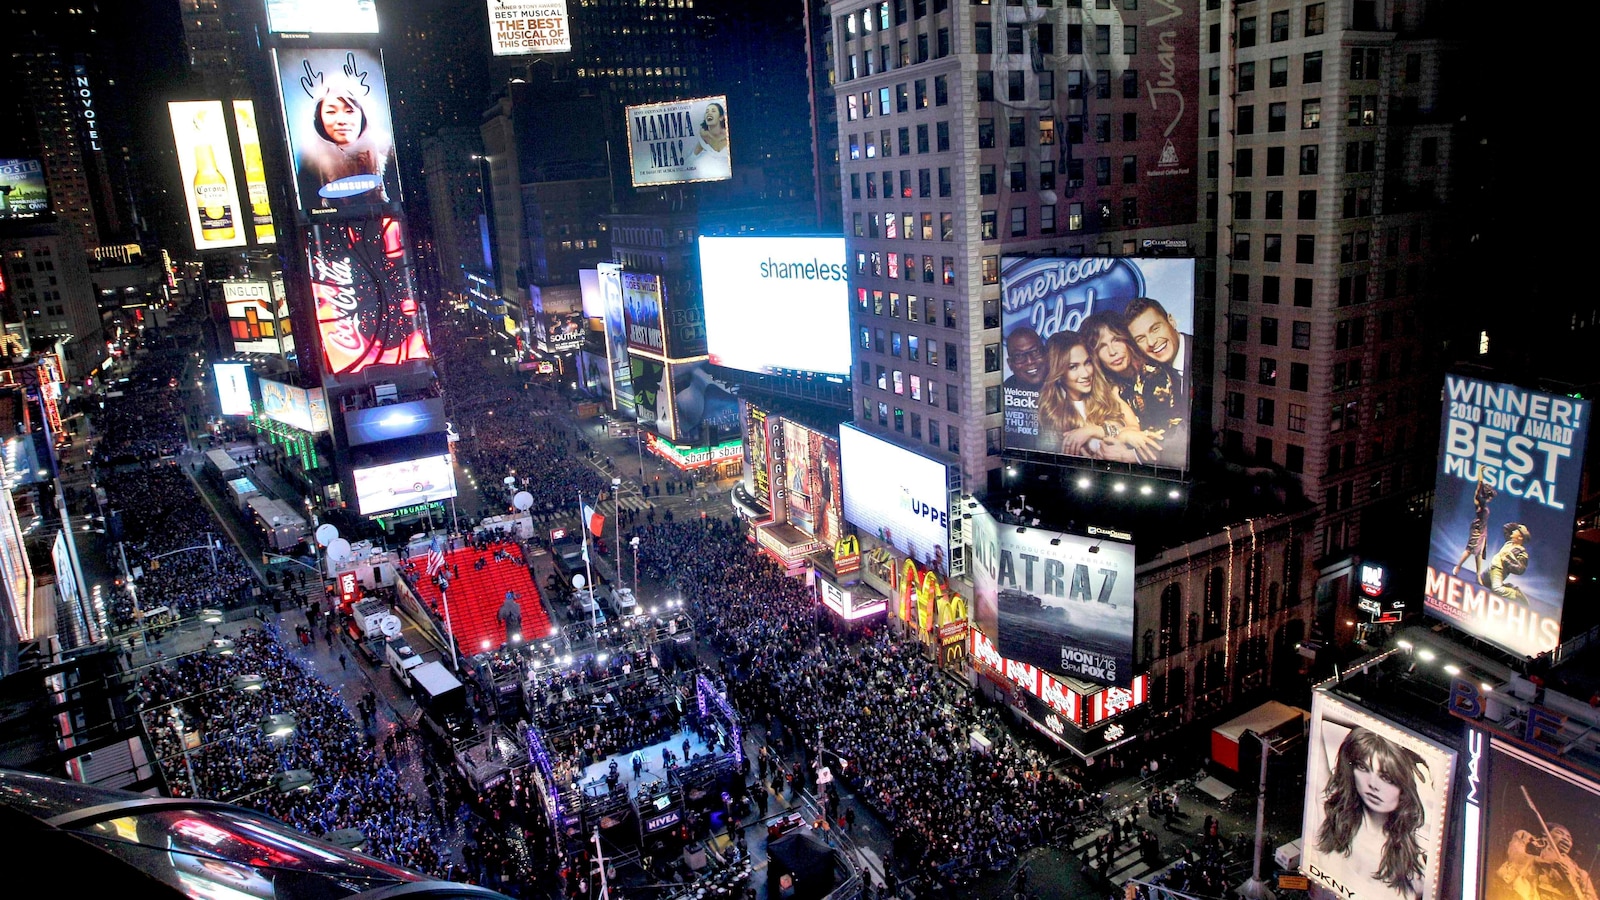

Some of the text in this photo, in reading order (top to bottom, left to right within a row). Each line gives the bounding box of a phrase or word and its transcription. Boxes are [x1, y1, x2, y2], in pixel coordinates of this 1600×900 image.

[497, 29, 564, 40] MUSICAL OF
[528, 18, 562, 30] BEST
[1146, 31, 1184, 137] Juan
[76, 77, 101, 150] NOVOTEL
[634, 111, 695, 142] MAMMA
[649, 140, 684, 168] MIA!
[196, 185, 225, 194] Corona
[326, 181, 375, 191] SAMSUNG
[760, 257, 848, 282] shameless
[226, 286, 264, 296] INGLOT
[1032, 288, 1094, 340] Idol
[1004, 387, 1039, 398] Welcome
[1005, 394, 1038, 408] Back.
[1447, 377, 1582, 428] WINNER!
[1005, 410, 1024, 419] WED
[1005, 418, 1024, 426] THU
[1450, 402, 1573, 445] 2010 TONY AWARD
[685, 452, 715, 464] sbarro
[772, 424, 784, 499] PALACE
[1446, 418, 1570, 483] BEST
[1444, 454, 1564, 509] MUSICAL
[912, 498, 947, 528] UPPE
[1010, 544, 1057, 557] PRODUCER
[1080, 556, 1118, 568] ABRAMS
[1425, 566, 1560, 650] MEMPHIS
[1061, 649, 1116, 671] MON 1/16
[1061, 659, 1116, 681] 8PM FOX 5
[648, 814, 679, 830] NIVEA
[1310, 864, 1355, 898] DKNY
